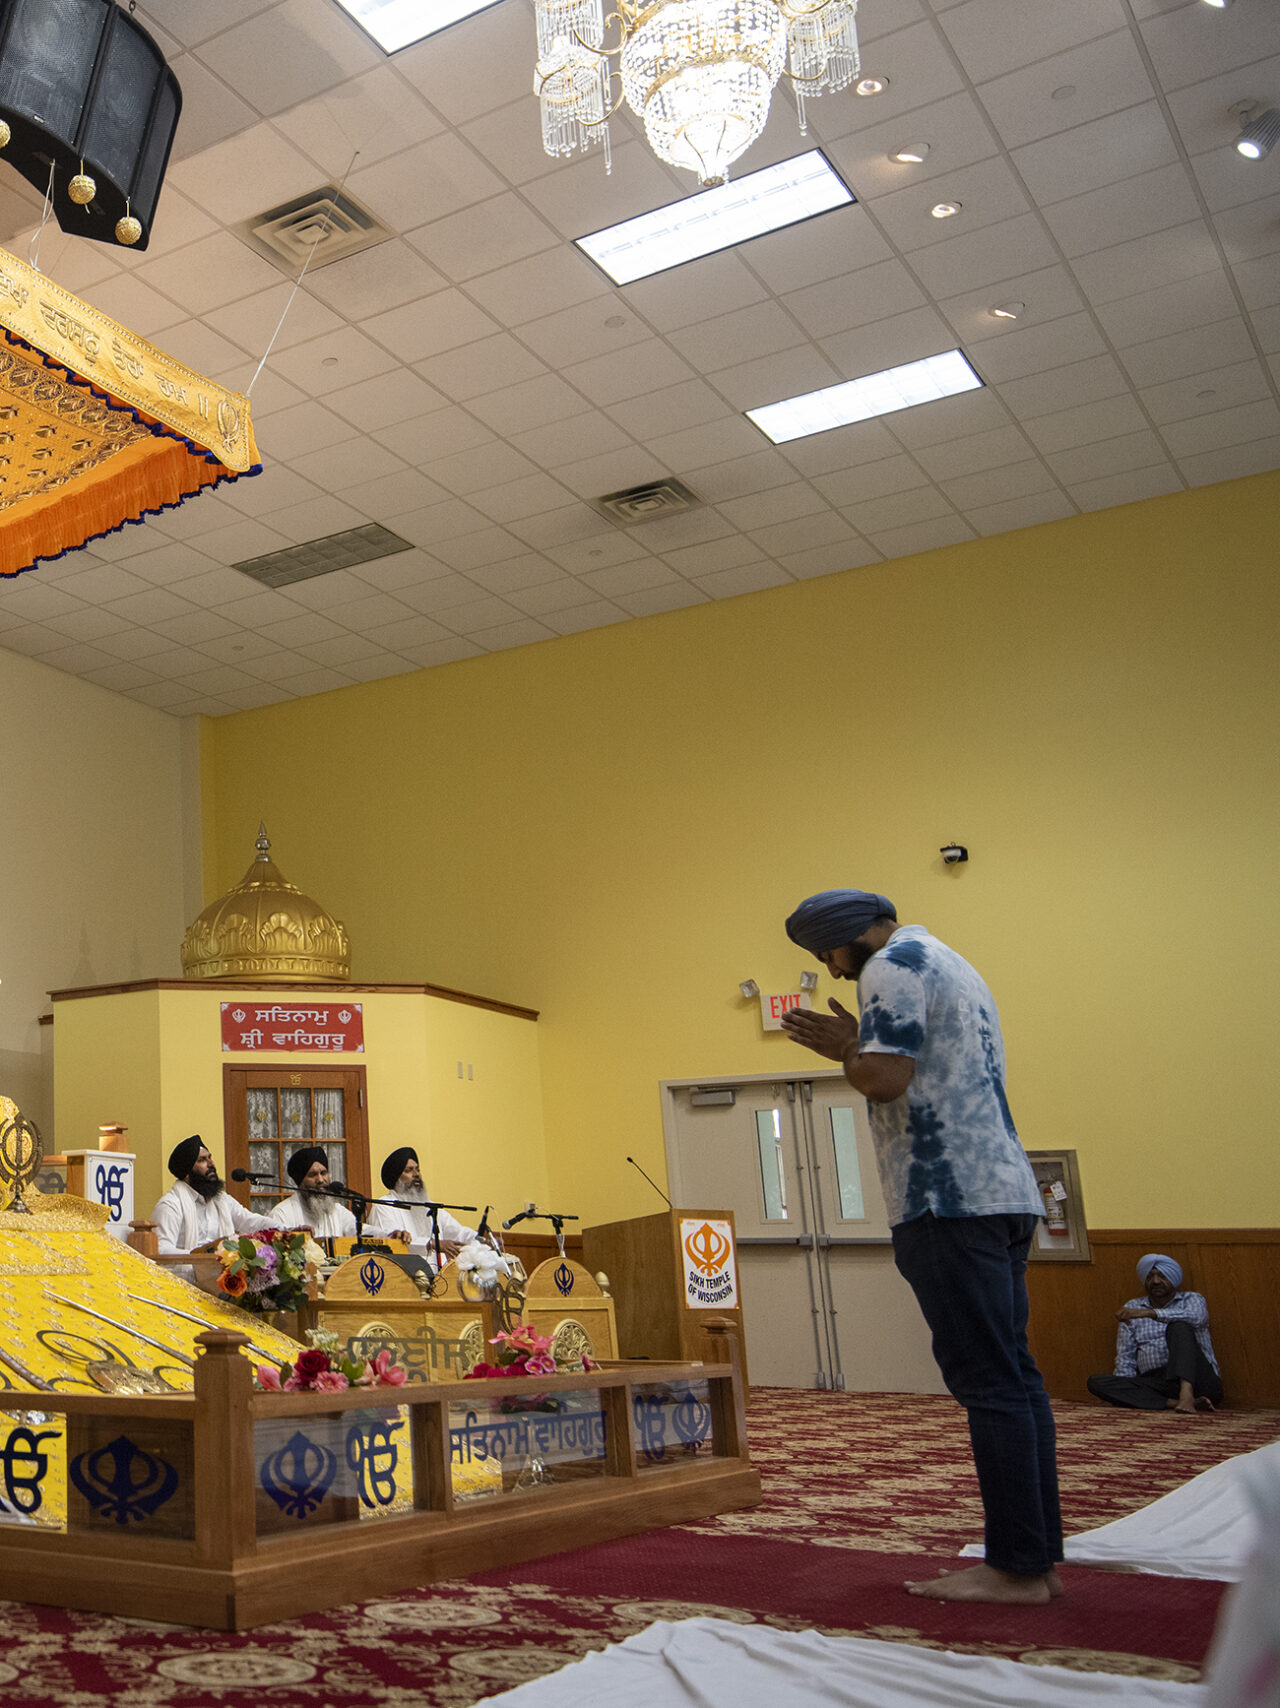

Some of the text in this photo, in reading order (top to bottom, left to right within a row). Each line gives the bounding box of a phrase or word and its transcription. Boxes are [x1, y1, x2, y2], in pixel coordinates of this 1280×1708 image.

[255, 1006, 329, 1025] ਸਤਿਨਾਮੁ
[770, 994, 800, 1019] EXIT
[240, 1028, 346, 1051] ਸ੍ਰੀ ਵਾਹਿਗੁਰੂ
[96, 1164, 129, 1222] ੴ
[689, 1271, 731, 1289] SIKH TEMPLE
[688, 1283, 733, 1303] OF WISCONSIN
[633, 1395, 670, 1461] ੴ
[345, 1421, 406, 1509] ੴ
